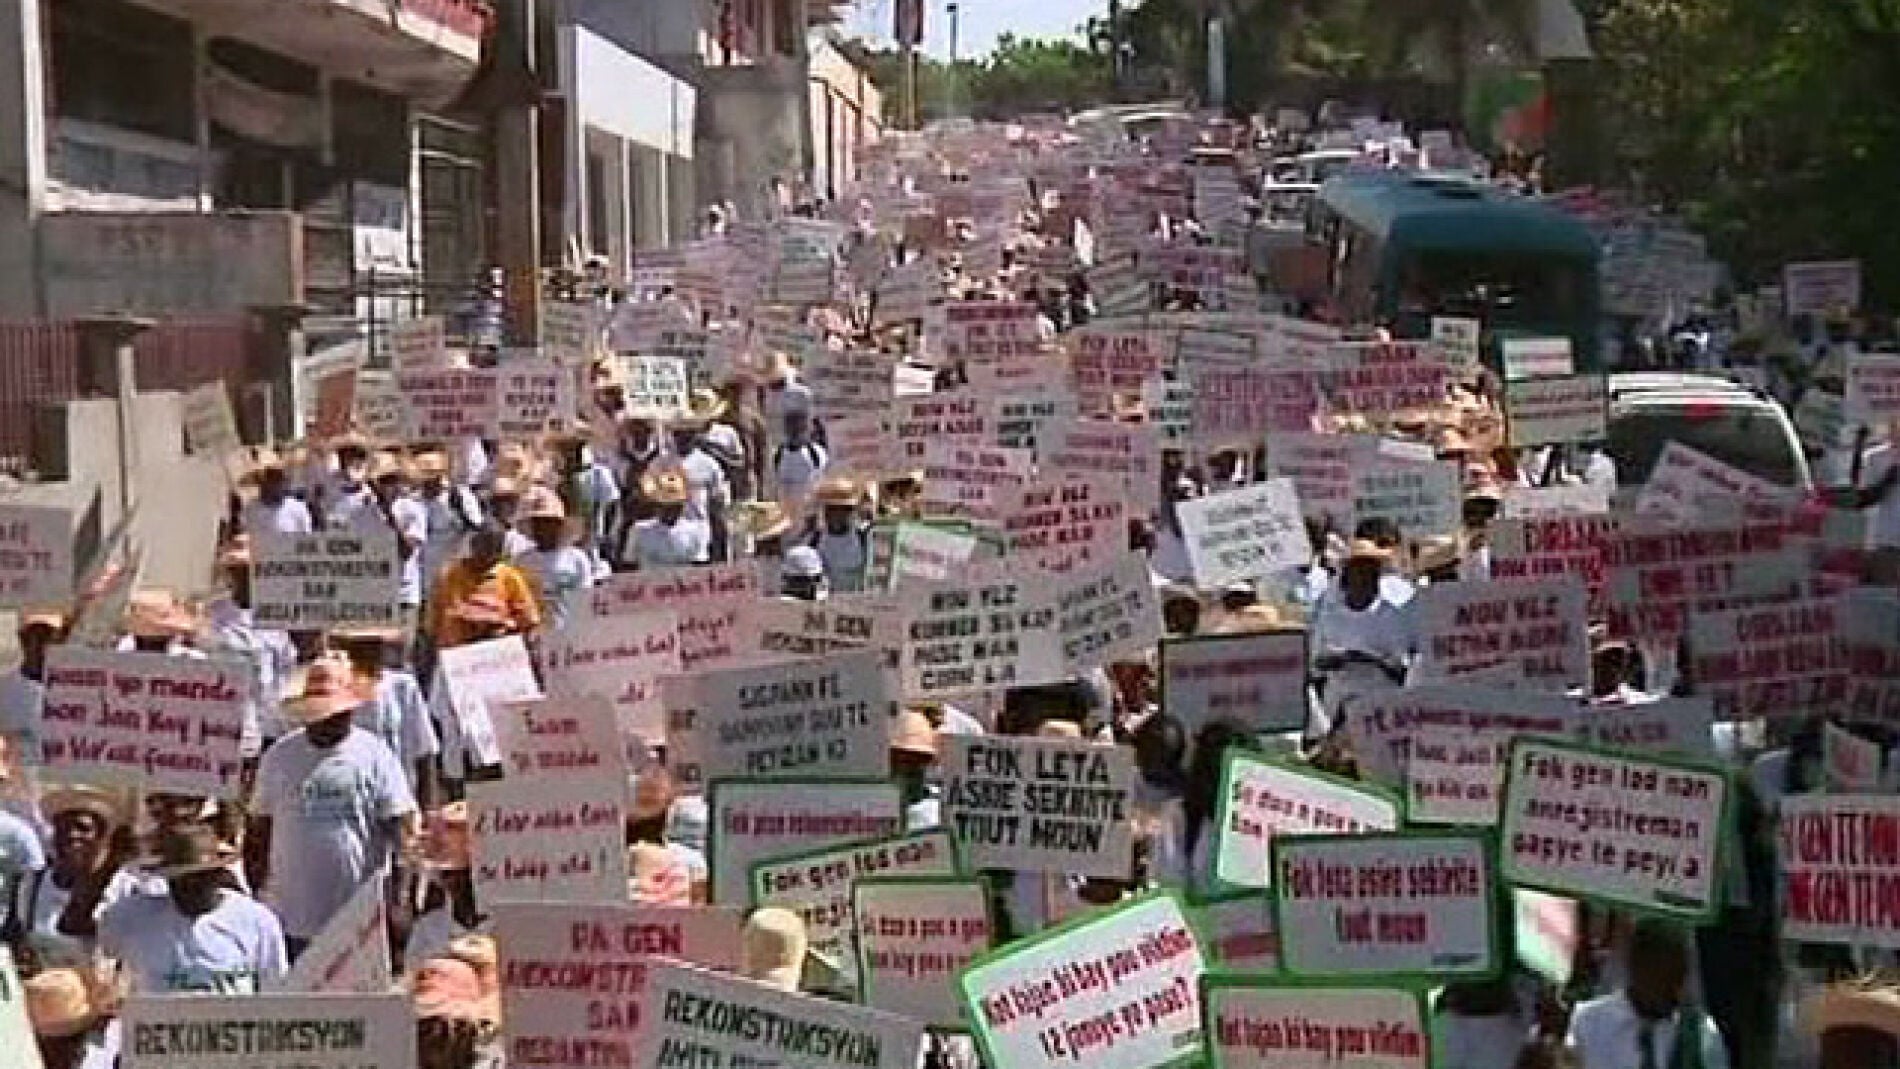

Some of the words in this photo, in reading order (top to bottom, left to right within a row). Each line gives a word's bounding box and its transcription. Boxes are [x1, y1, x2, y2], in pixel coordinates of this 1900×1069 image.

[1036, 750, 1109, 783] LETA
[955, 813, 1019, 846] TOUT
[1030, 817, 1103, 853] MOUN
[573, 923, 610, 953] PA
[623, 924, 684, 956] GEN
